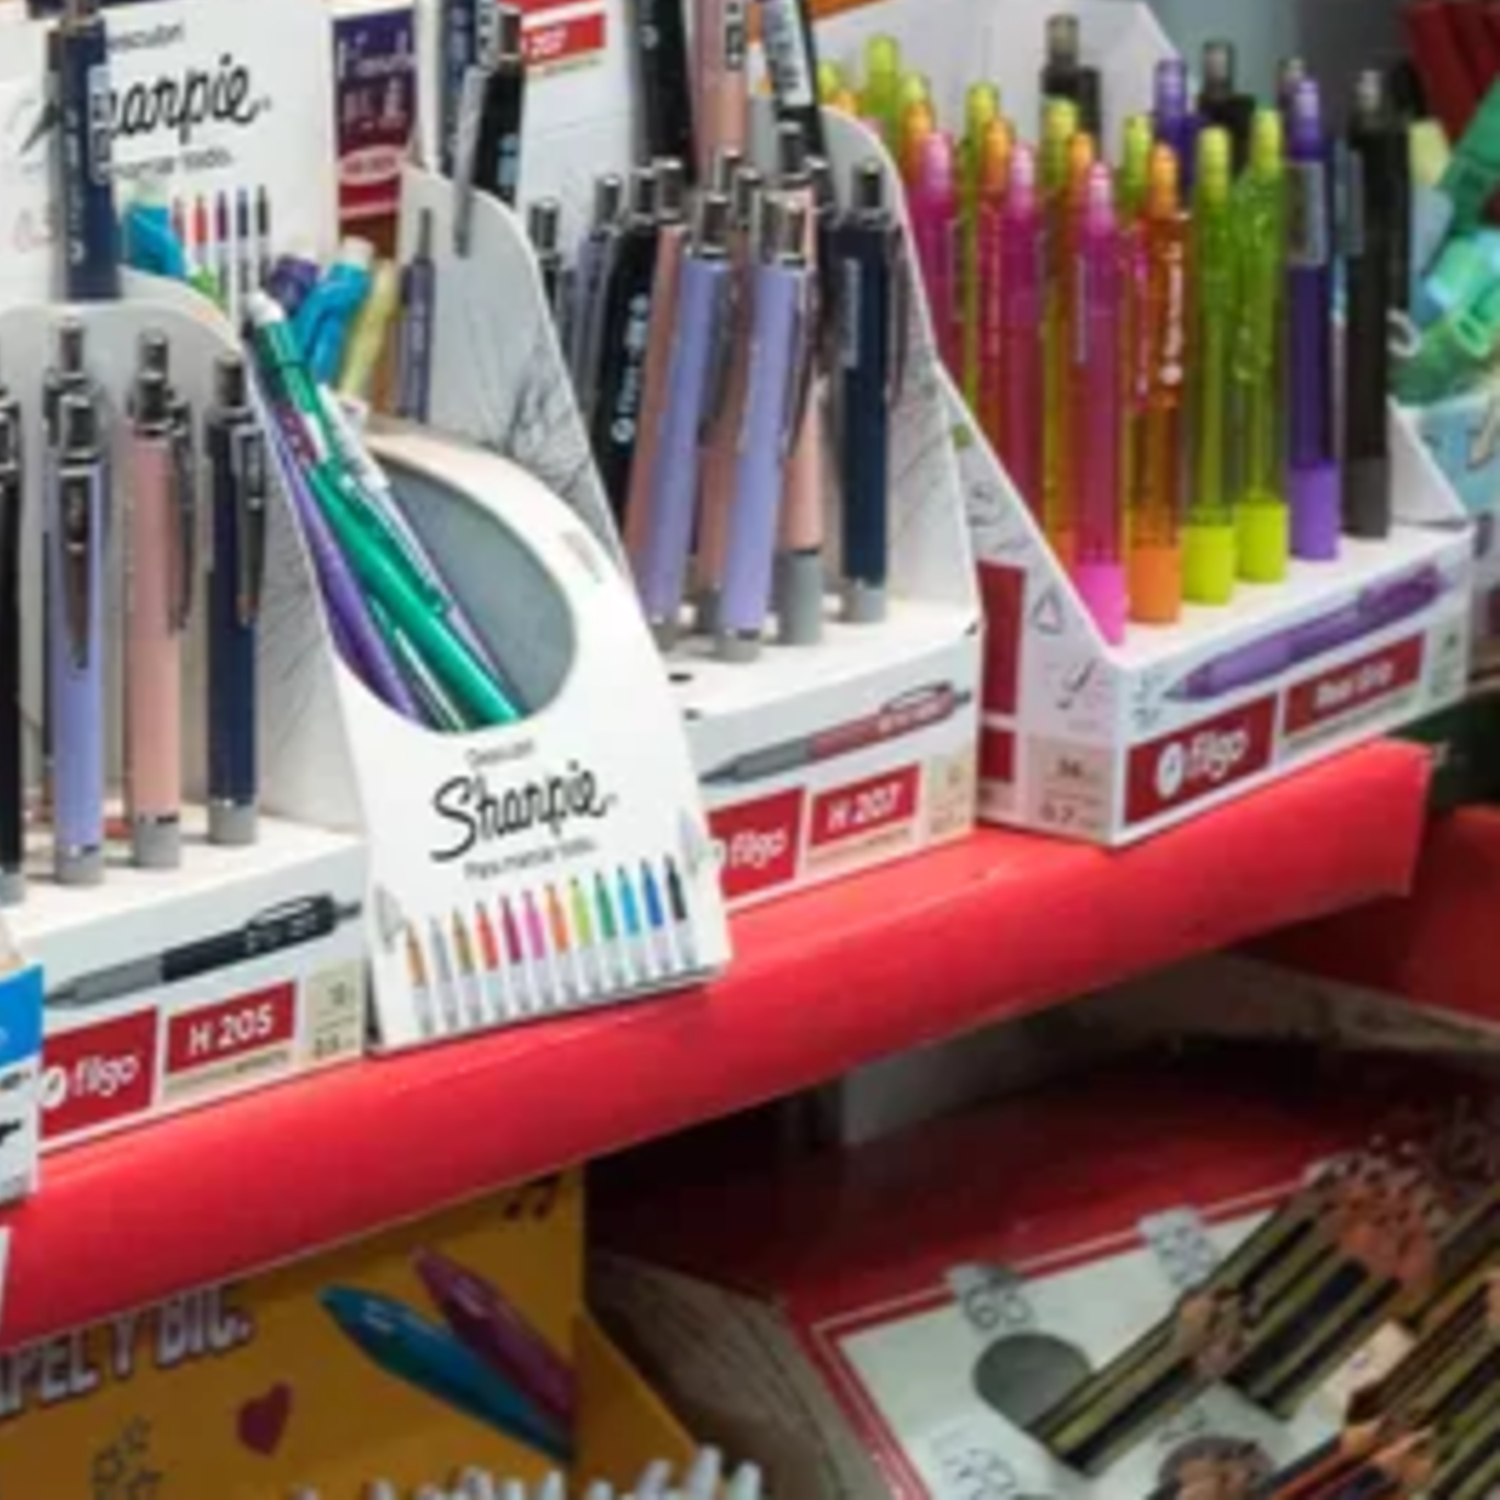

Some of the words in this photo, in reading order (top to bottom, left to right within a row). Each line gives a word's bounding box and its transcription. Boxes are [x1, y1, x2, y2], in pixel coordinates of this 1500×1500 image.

[110, 53, 260, 145] arpie
[1187, 730, 1250, 779] filgo
[430, 758, 608, 864] Sharpie
[729, 828, 789, 870] filgo
[186, 1022, 212, 1058] H
[218, 1001, 274, 1049] 205
[70, 1051, 141, 1098] filgo
